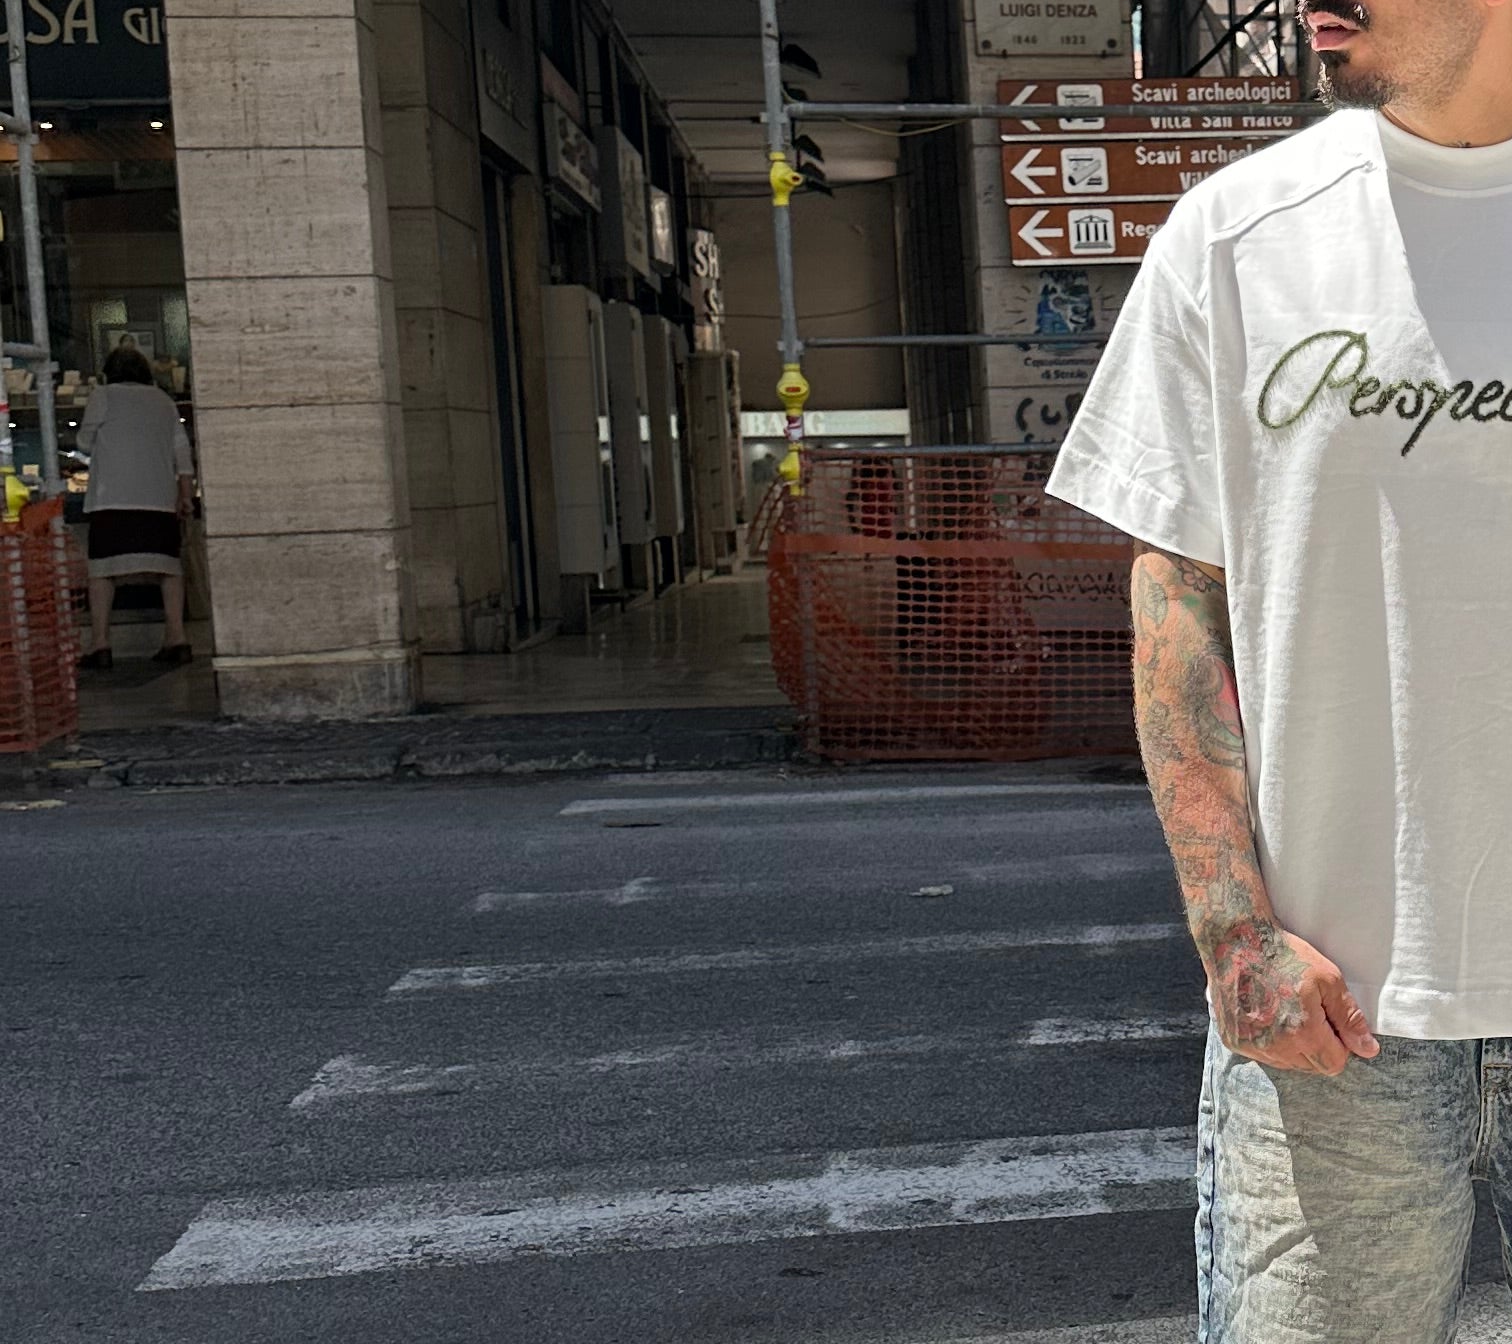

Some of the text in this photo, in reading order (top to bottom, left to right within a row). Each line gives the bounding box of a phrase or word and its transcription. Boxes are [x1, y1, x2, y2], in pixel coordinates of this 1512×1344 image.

[999, 3, 1098, 18] LUIGI DENZA
[1132, 81, 1291, 105] Scavi archeologici
[1135, 145, 1181, 166] Scavi
